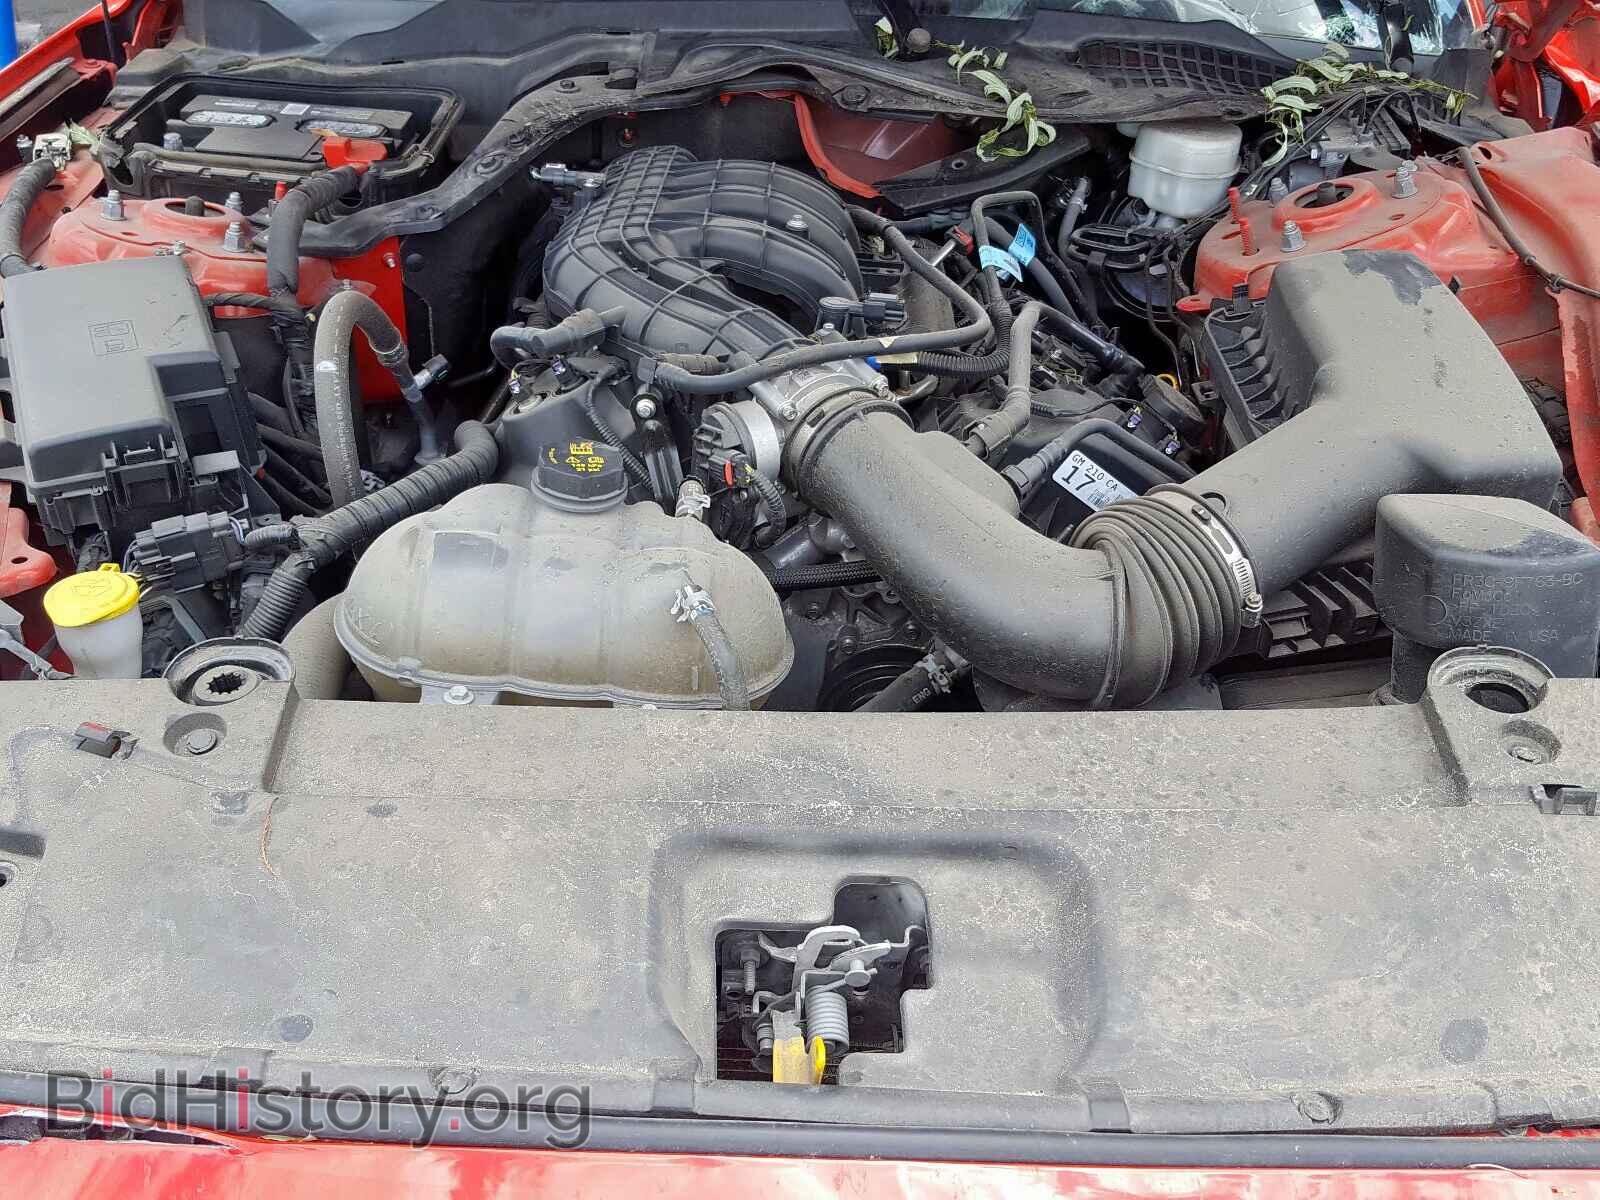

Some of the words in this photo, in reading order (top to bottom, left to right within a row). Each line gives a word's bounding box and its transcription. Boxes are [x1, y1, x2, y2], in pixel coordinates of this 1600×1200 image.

[1062, 465, 1096, 491] 17
[1071, 454, 1086, 466] GM
[1105, 479, 1118, 491] CA
[1448, 628, 1493, 642] MADE
[1528, 629, 1560, 642] USA
